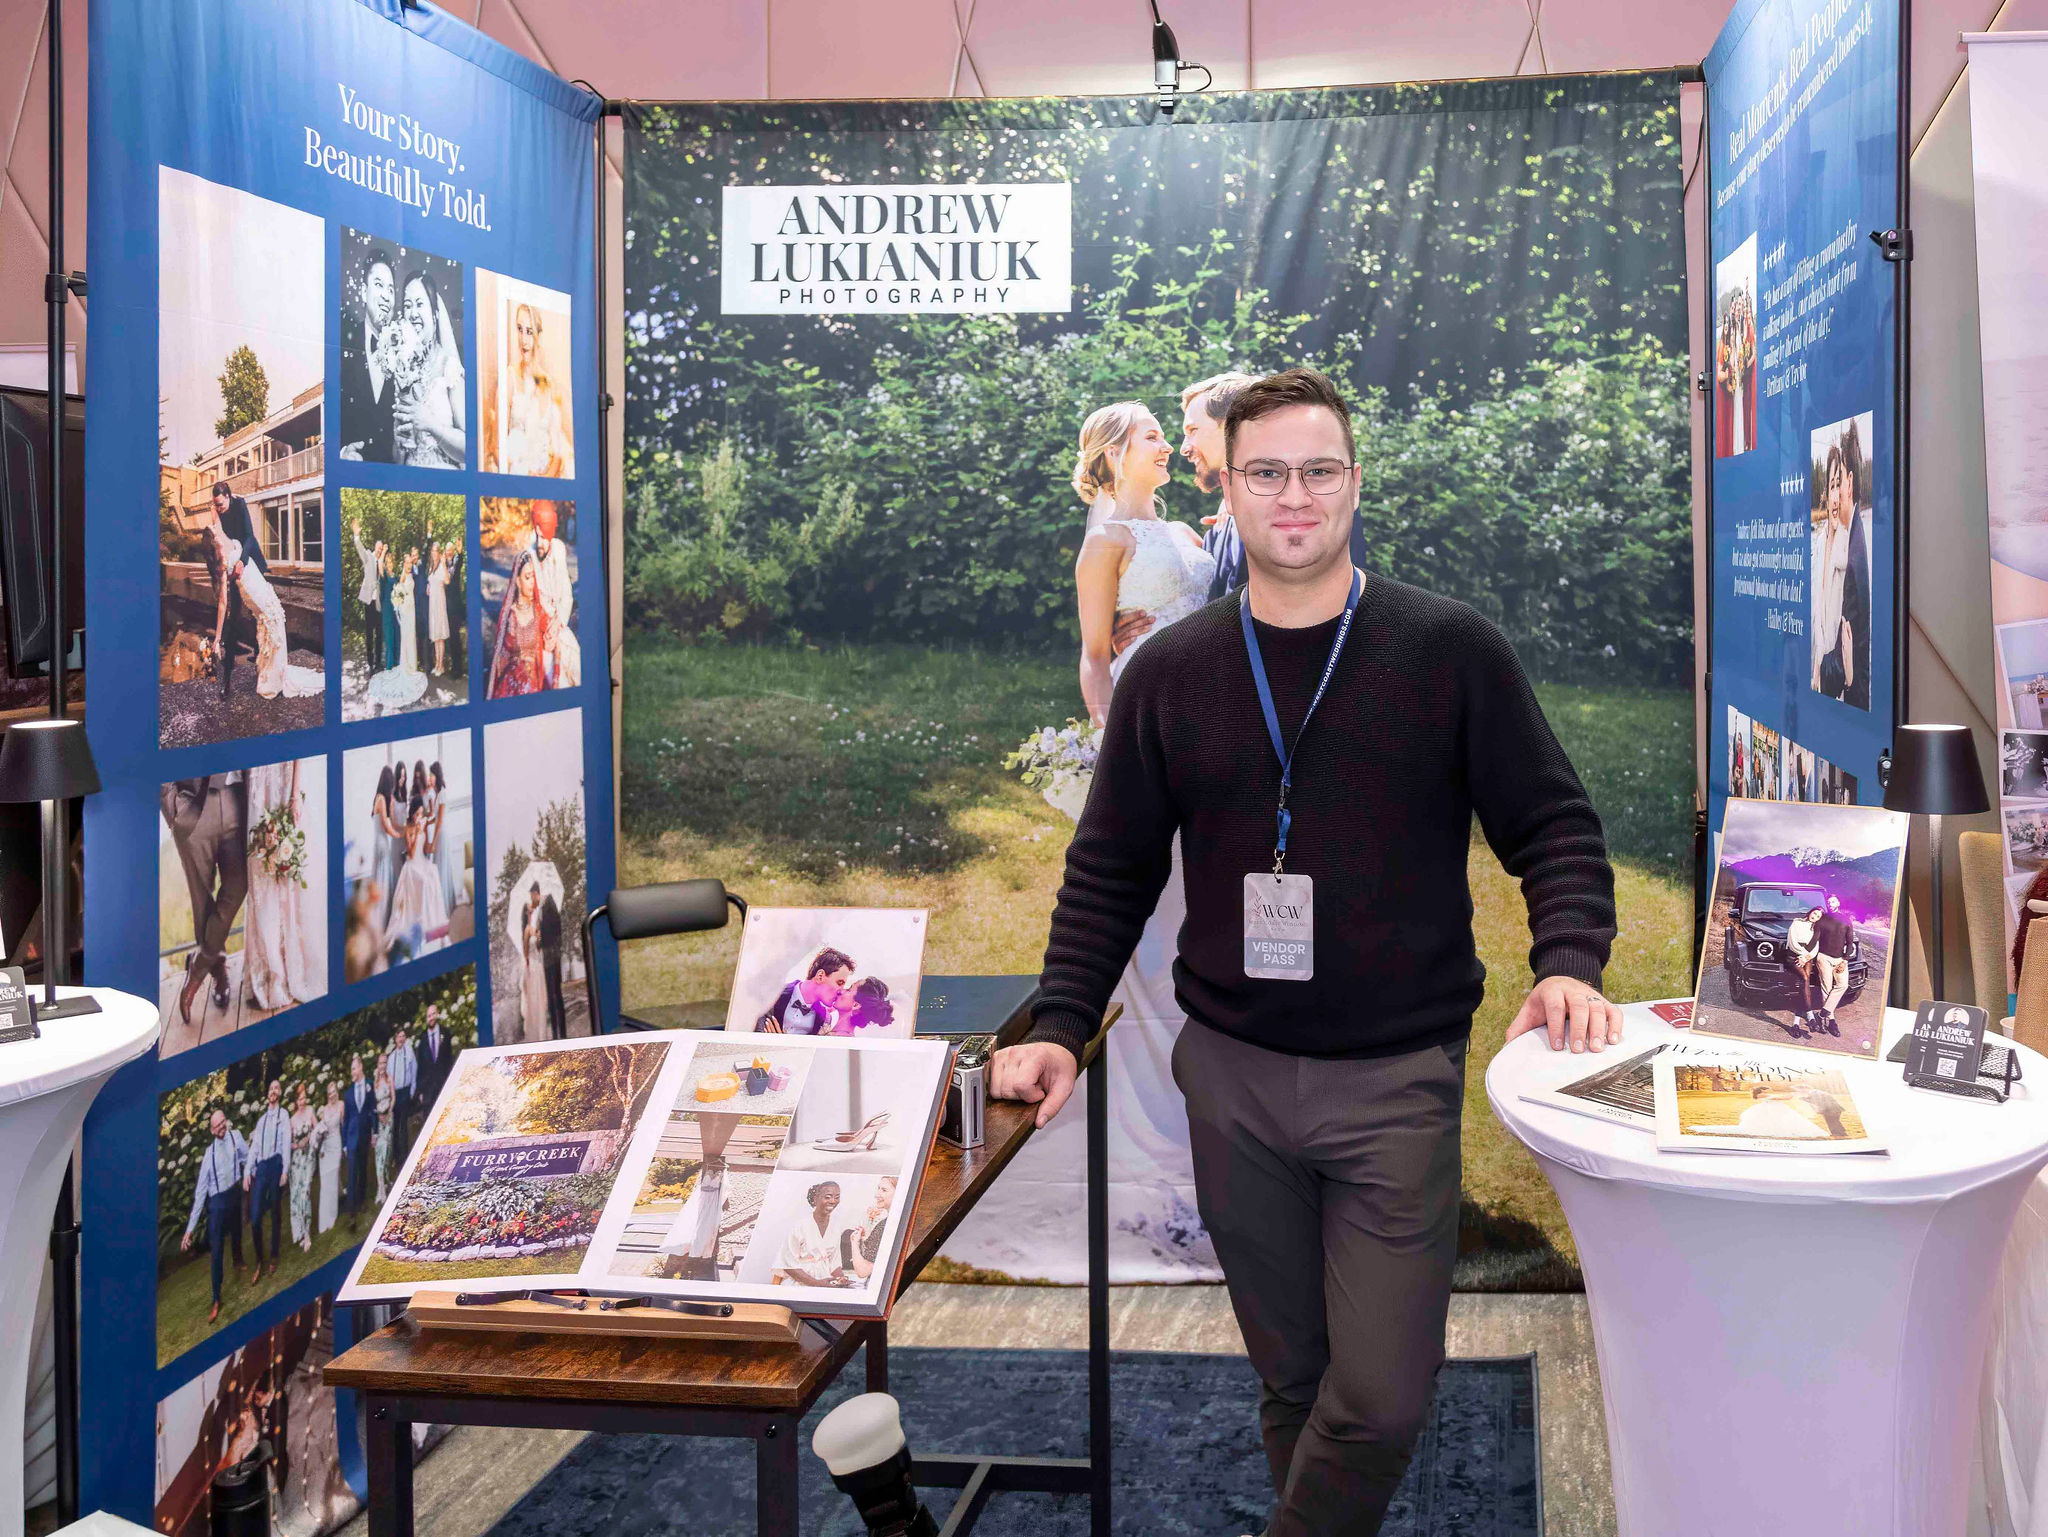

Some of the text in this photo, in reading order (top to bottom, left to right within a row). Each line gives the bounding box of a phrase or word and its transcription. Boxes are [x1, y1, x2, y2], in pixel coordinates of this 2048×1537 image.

[1730, 114, 1746, 165] Real
[1790, 22, 1809, 88] Real
[337, 82, 465, 175] Your Story.
[304, 126, 492, 232] Beautifully Told.
[777, 194, 1012, 235] ANDREW
[750, 240, 1041, 282] LUKIANIUK
[780, 287, 1009, 304] PHOTOGRAPHY
[1262, 904, 1303, 919] WCW
[1252, 942, 1306, 954] VENDOR
[1263, 954, 1295, 965] PASS
[1931, 1030, 1975, 1046] LUKIANIUK
[1937, 1025, 1972, 1038] ANDREW
[460, 1146, 582, 1168] FURRY CREEK
